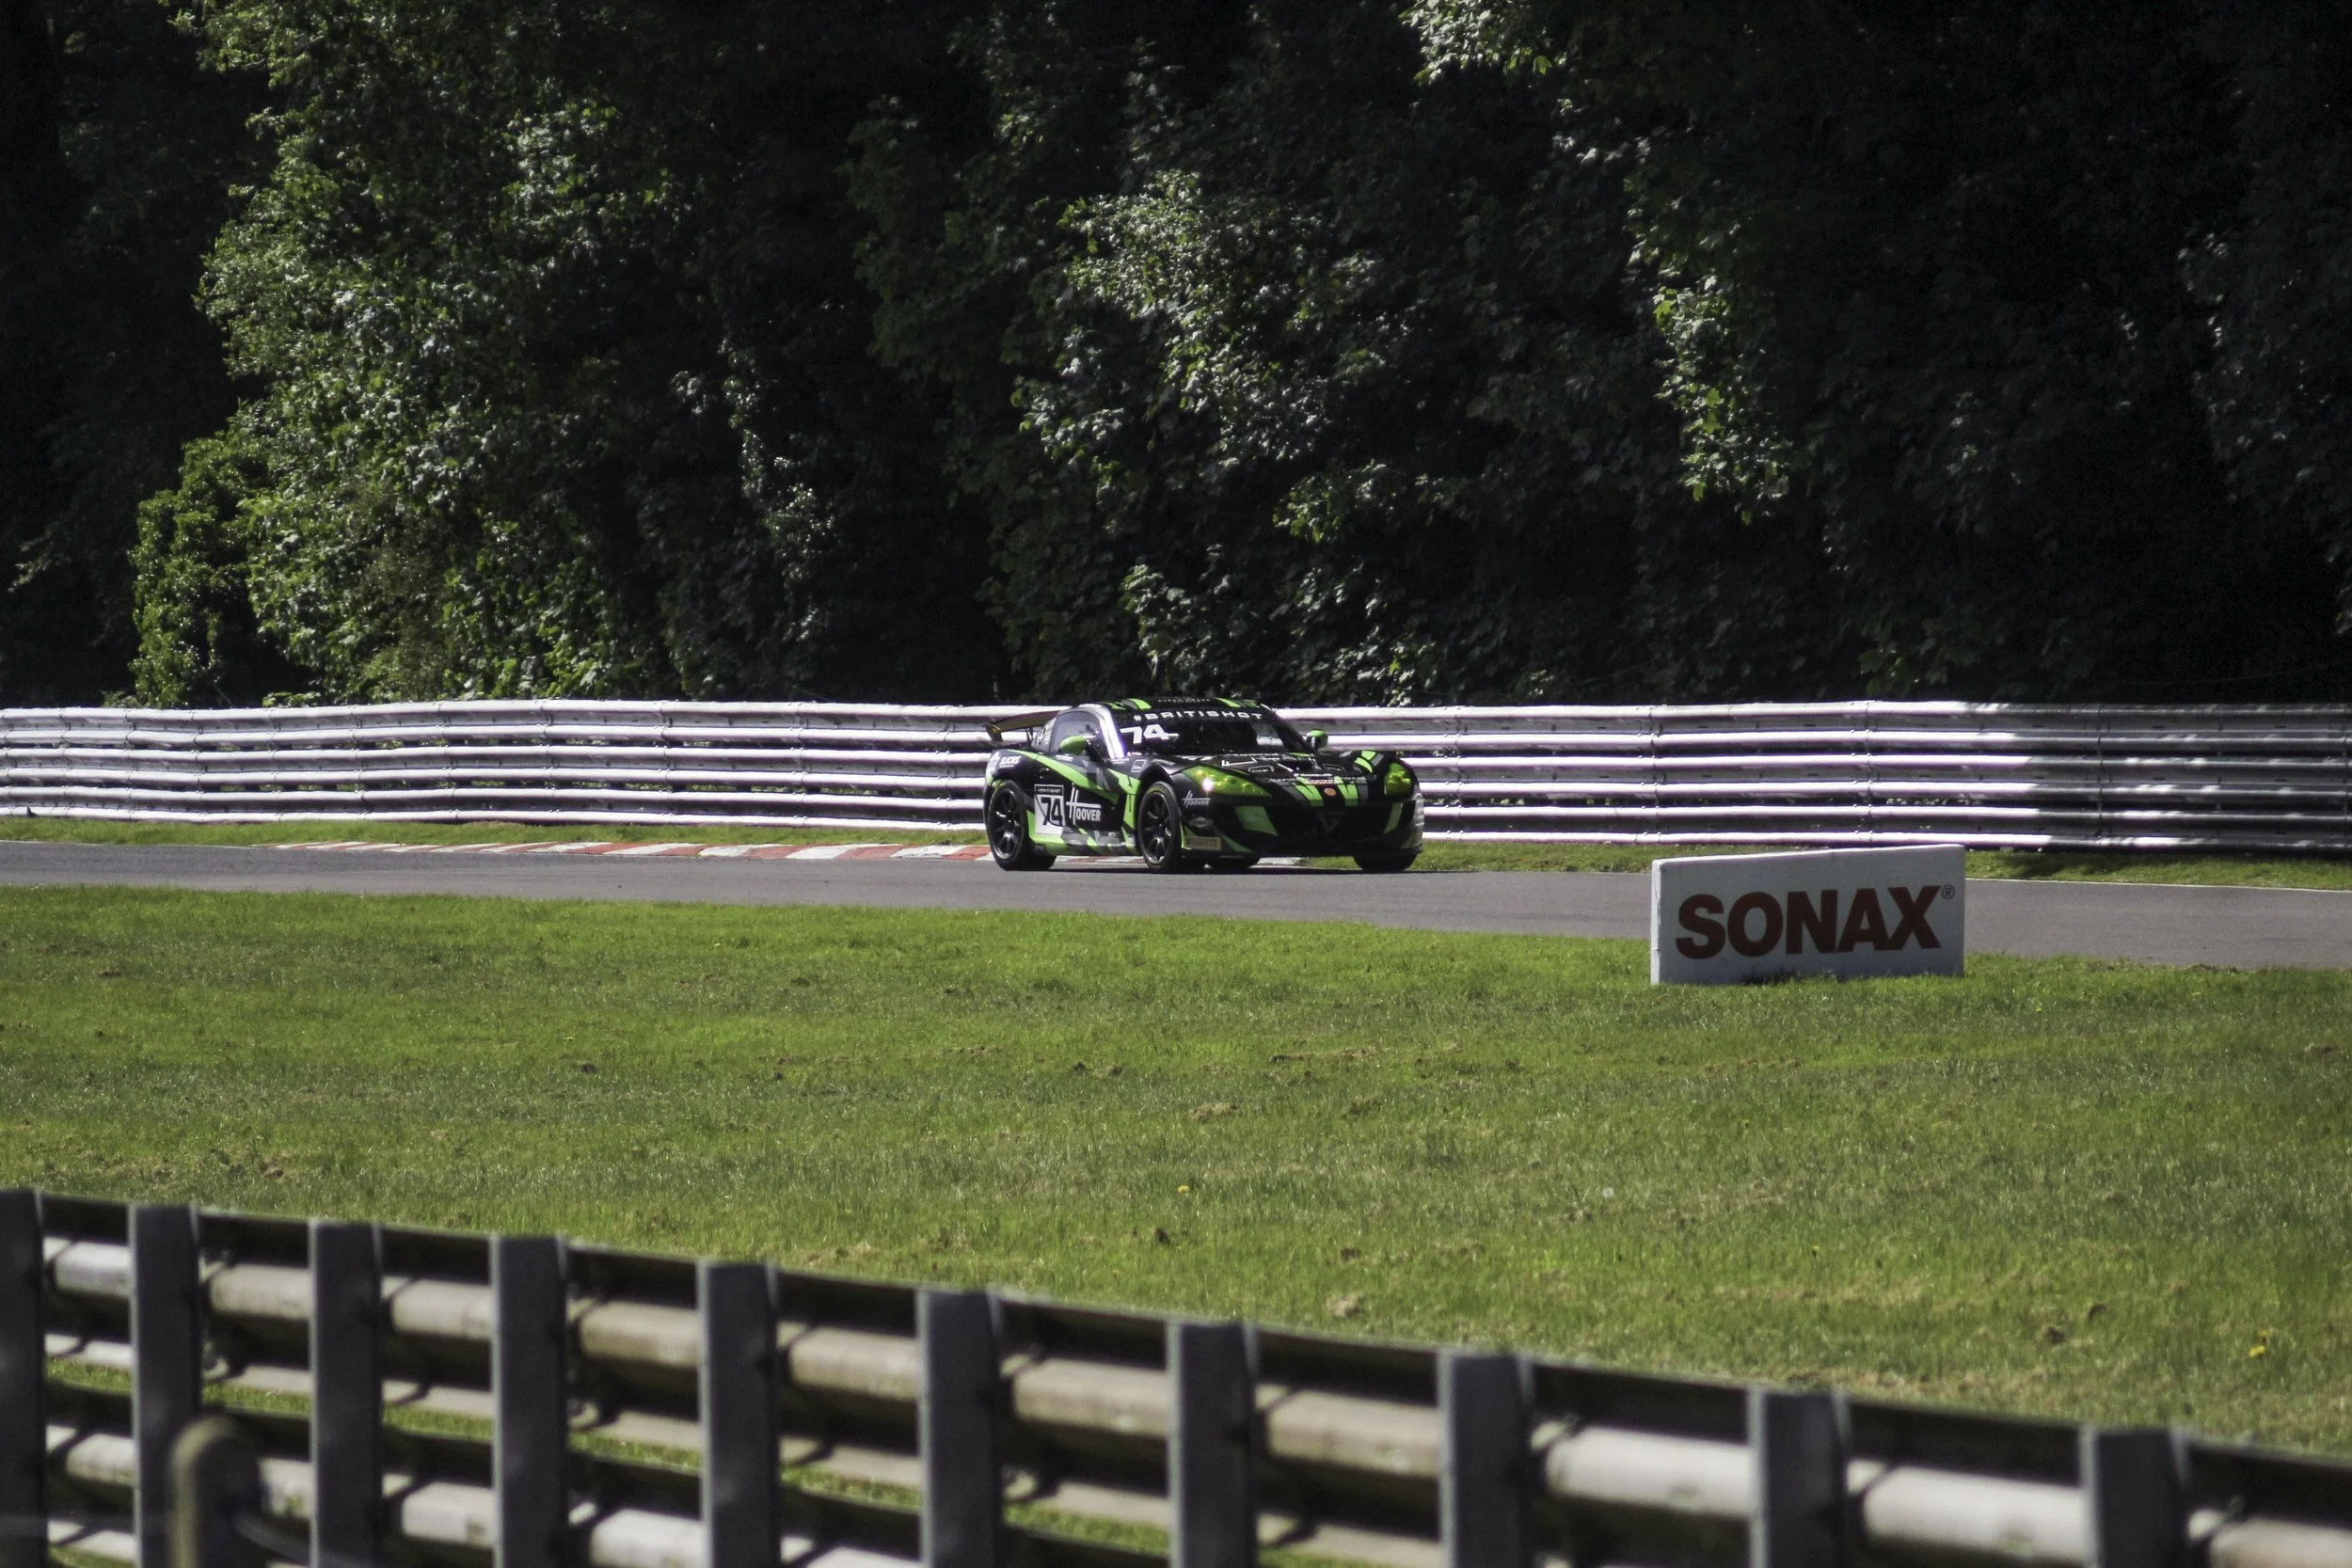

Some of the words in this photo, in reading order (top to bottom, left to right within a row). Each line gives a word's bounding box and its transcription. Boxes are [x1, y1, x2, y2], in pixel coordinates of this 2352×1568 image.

[1120, 723, 1173, 744] 74
[1041, 797, 1063, 826] 74
[1066, 783, 1102, 825] HOOVER
[1182, 790, 1211, 808] HOOVER
